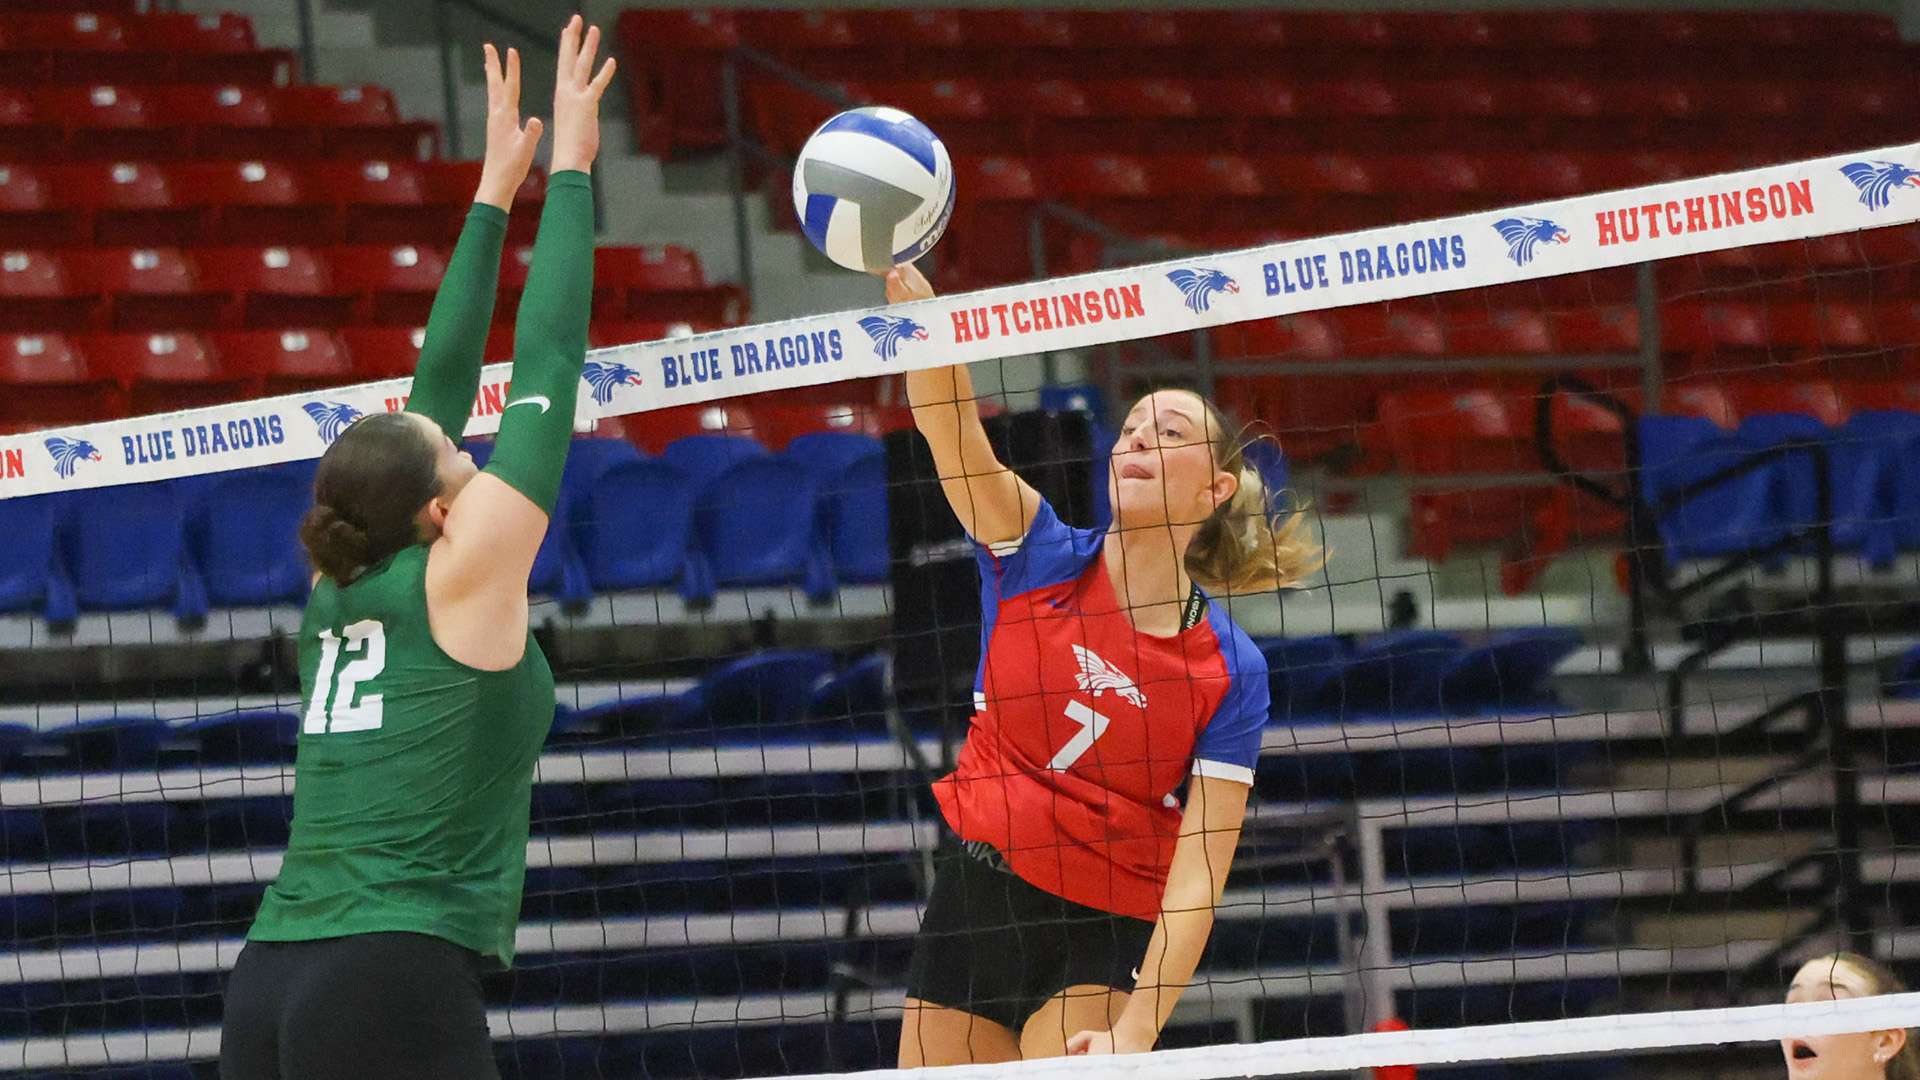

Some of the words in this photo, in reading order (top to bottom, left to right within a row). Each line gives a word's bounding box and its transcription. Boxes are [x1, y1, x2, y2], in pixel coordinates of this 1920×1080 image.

[1595, 179, 1815, 246] HUTCHINSON
[1262, 255, 1329, 297] BLUE
[1340, 235, 1466, 286] DRAGONS
[951, 284, 1146, 344] HUTCHINSON
[661, 348, 722, 389] BLUE
[731, 329, 843, 376] DRAGONS
[121, 430, 177, 465] BLUE
[181, 415, 285, 456] DRAGONS
[304, 619, 386, 734] 12
[1046, 699, 1111, 774] 7
